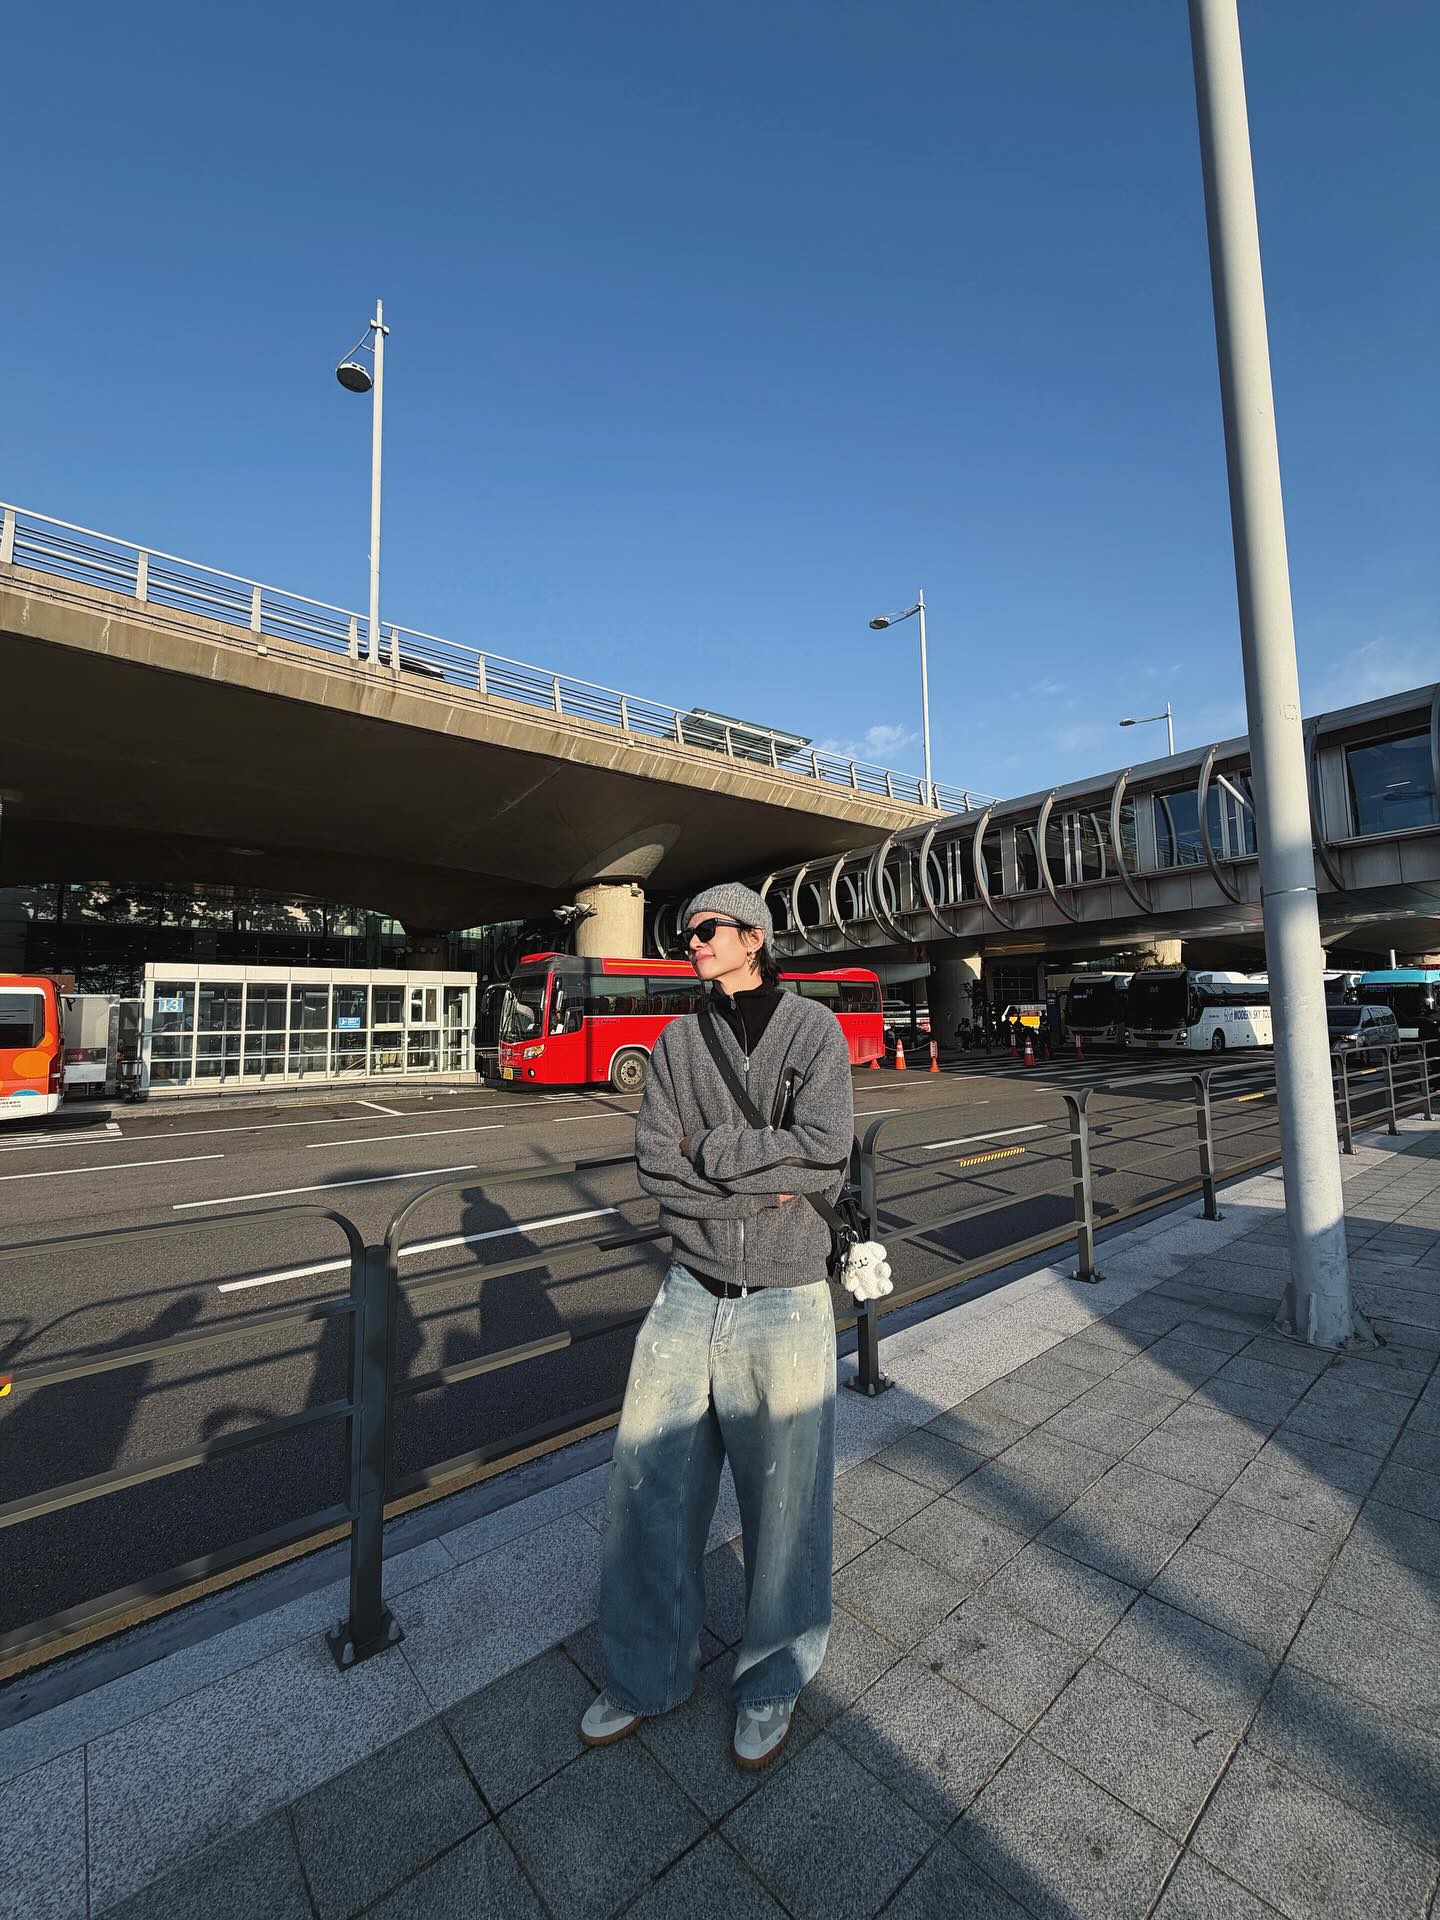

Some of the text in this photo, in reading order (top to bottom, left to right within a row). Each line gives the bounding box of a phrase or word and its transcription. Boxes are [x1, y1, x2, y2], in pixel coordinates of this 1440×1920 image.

[162, 999, 179, 1011] 13
[1234, 1010, 1252, 1020] MODERN
[1253, 1009, 1261, 1019] SKY
